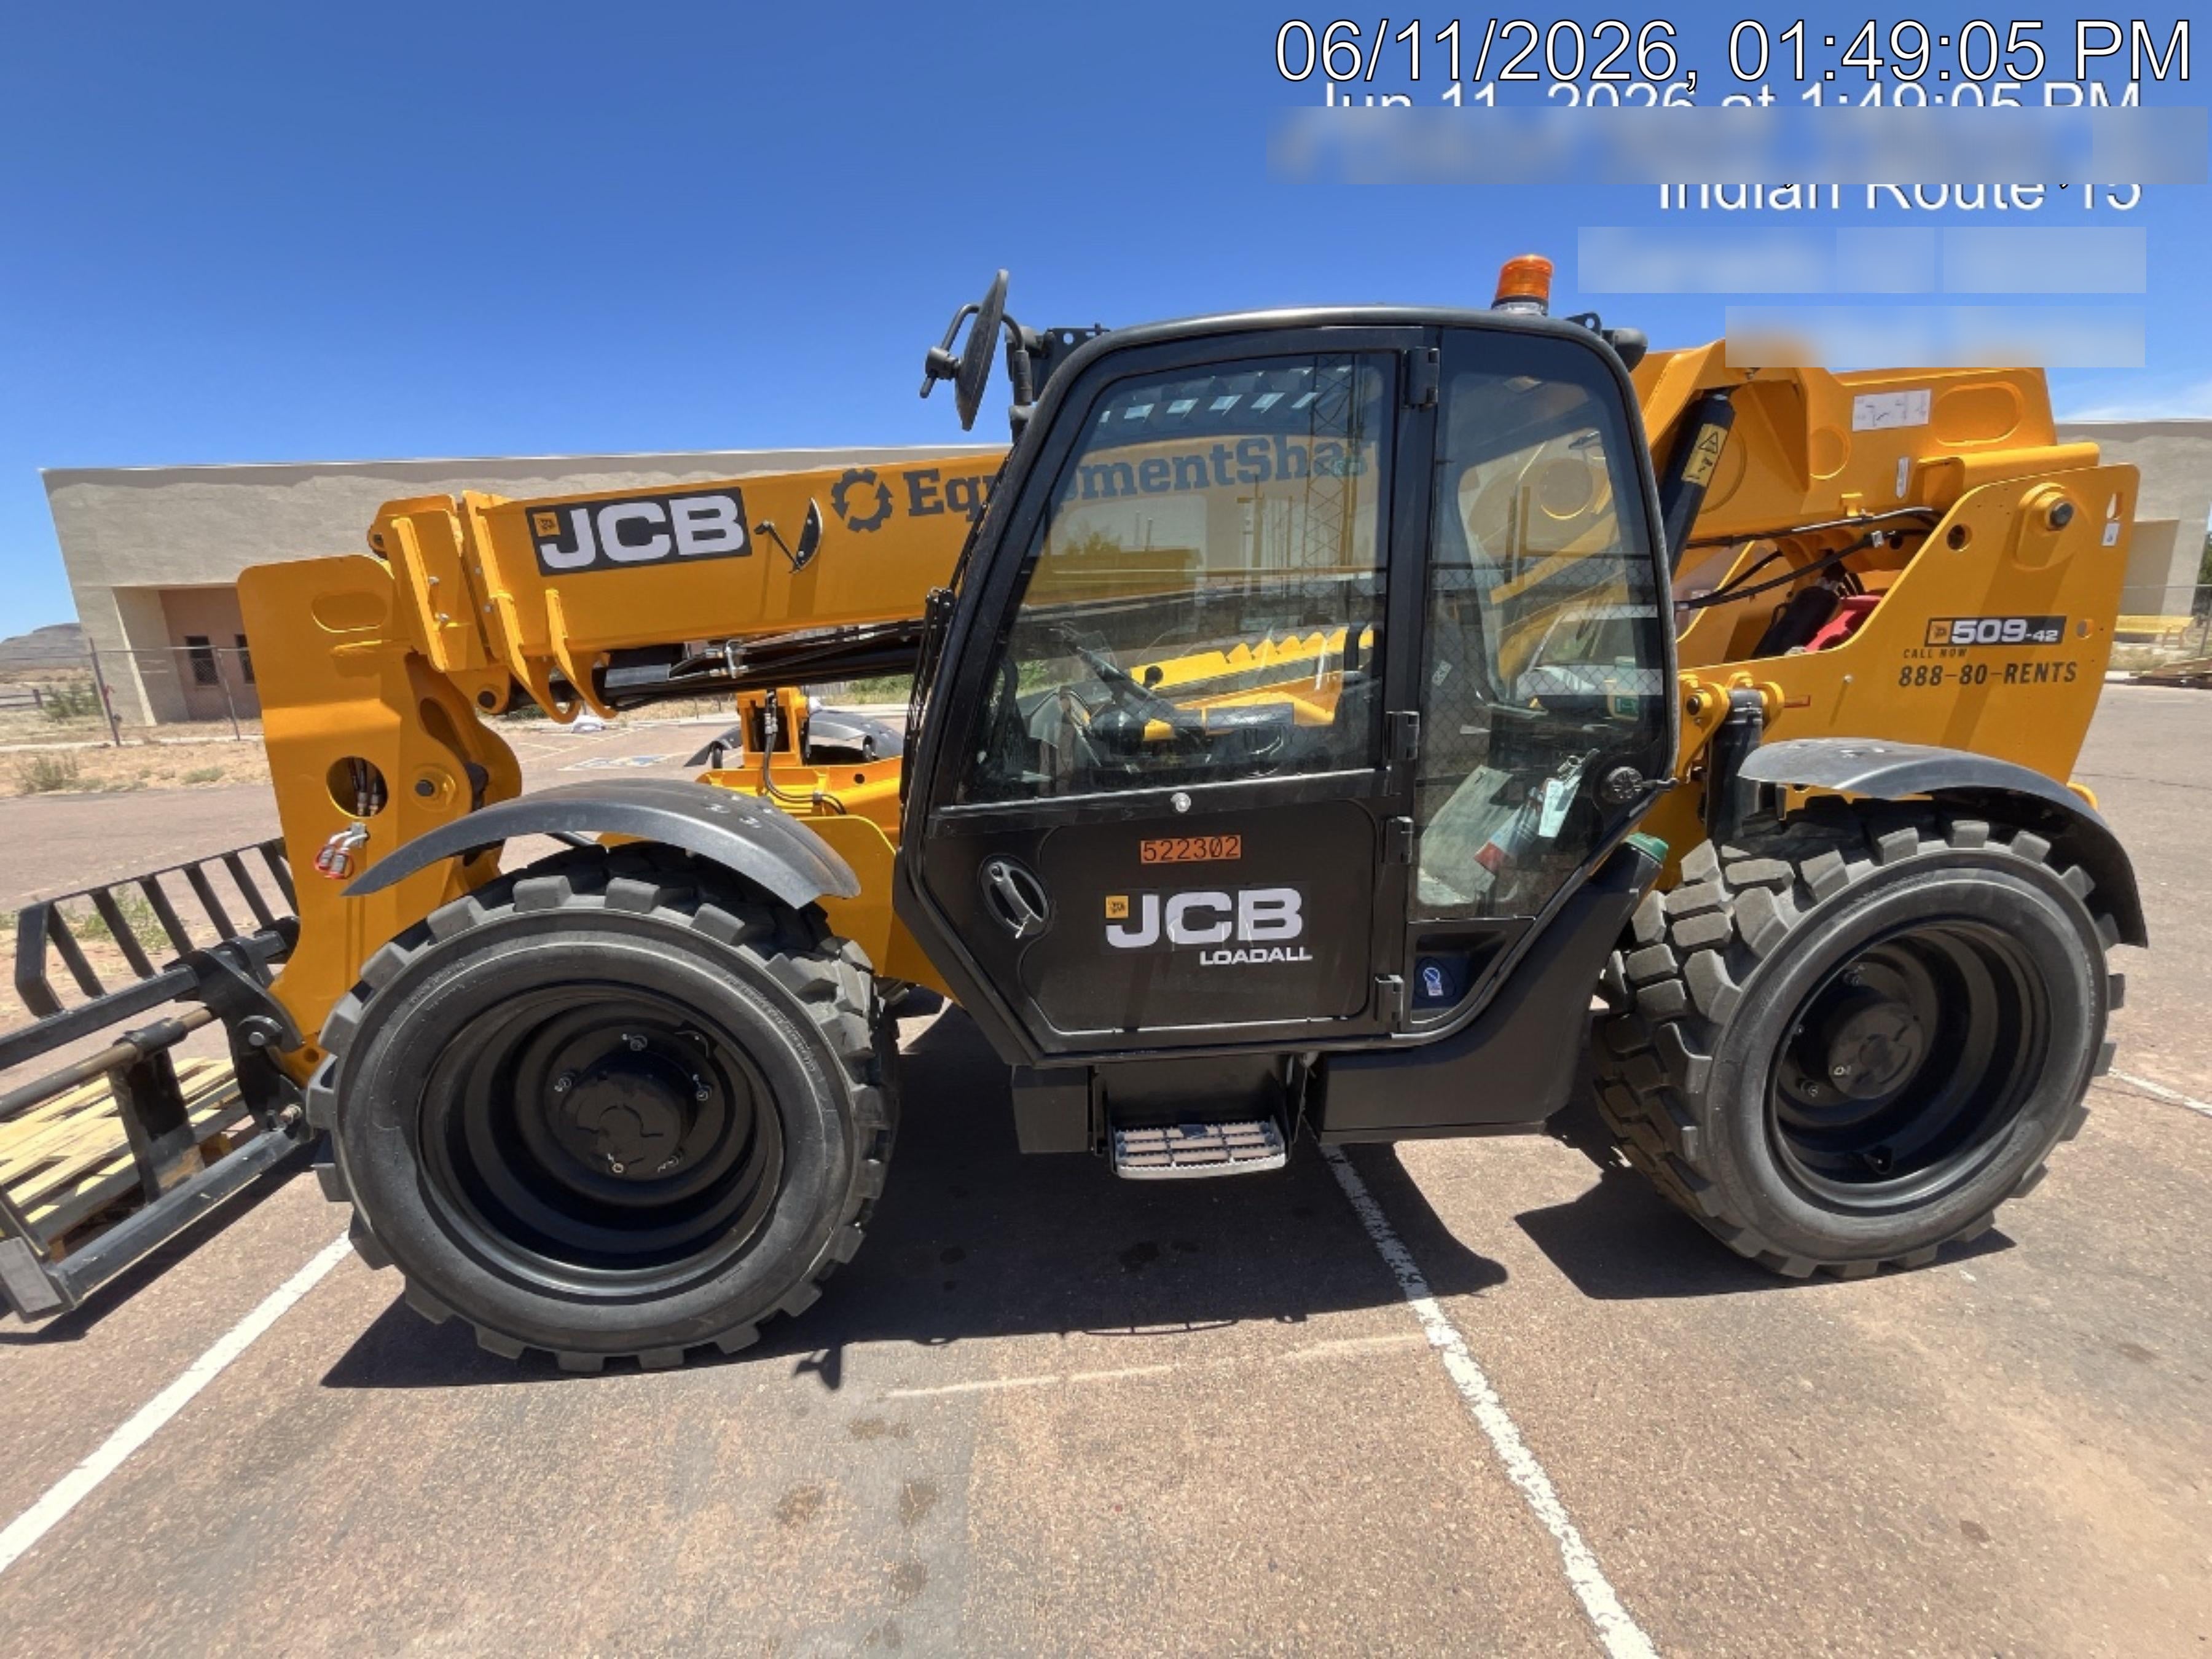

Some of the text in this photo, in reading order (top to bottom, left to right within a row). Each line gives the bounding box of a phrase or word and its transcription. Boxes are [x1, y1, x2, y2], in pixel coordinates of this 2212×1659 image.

[539, 495, 744, 569] JCB
[1951, 618, 2058, 644] 509-42
[1904, 648, 1967, 659] CALL NOW
[1898, 661, 2077, 687] 888-80-RENTS
[1142, 836, 1239, 861] 522302
[1106, 888, 1303, 949] JCB
[1199, 947, 1313, 966] LOADALL
